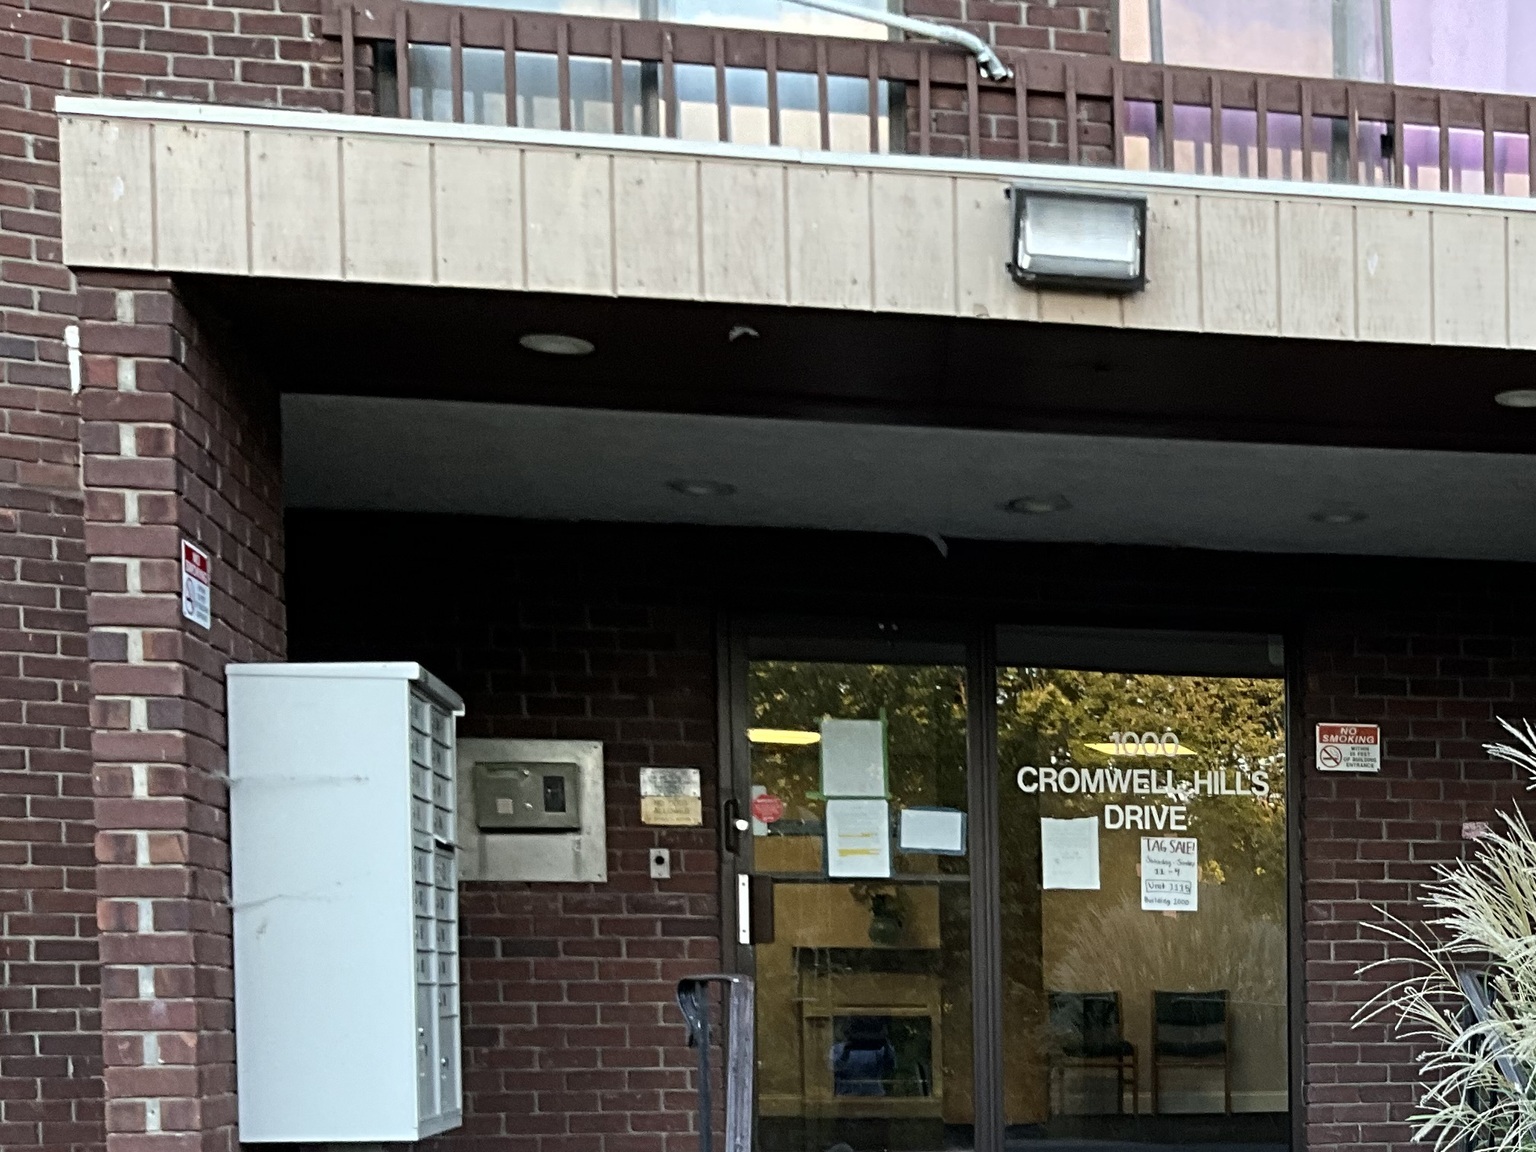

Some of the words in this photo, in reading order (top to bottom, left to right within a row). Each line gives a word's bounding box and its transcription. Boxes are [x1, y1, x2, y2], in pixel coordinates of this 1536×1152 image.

[1322, 734, 1375, 744] SMOKING
[1340, 727, 1357, 736] NO
[1109, 731, 1180, 757] 1000
[1017, 765, 1179, 795] CROMWELL
[1193, 770, 1270, 797] HILLS
[1104, 804, 1188, 831] DRIVE
[1143, 838, 1167, 852] TAG
[1169, 839, 1196, 855] SALE!
